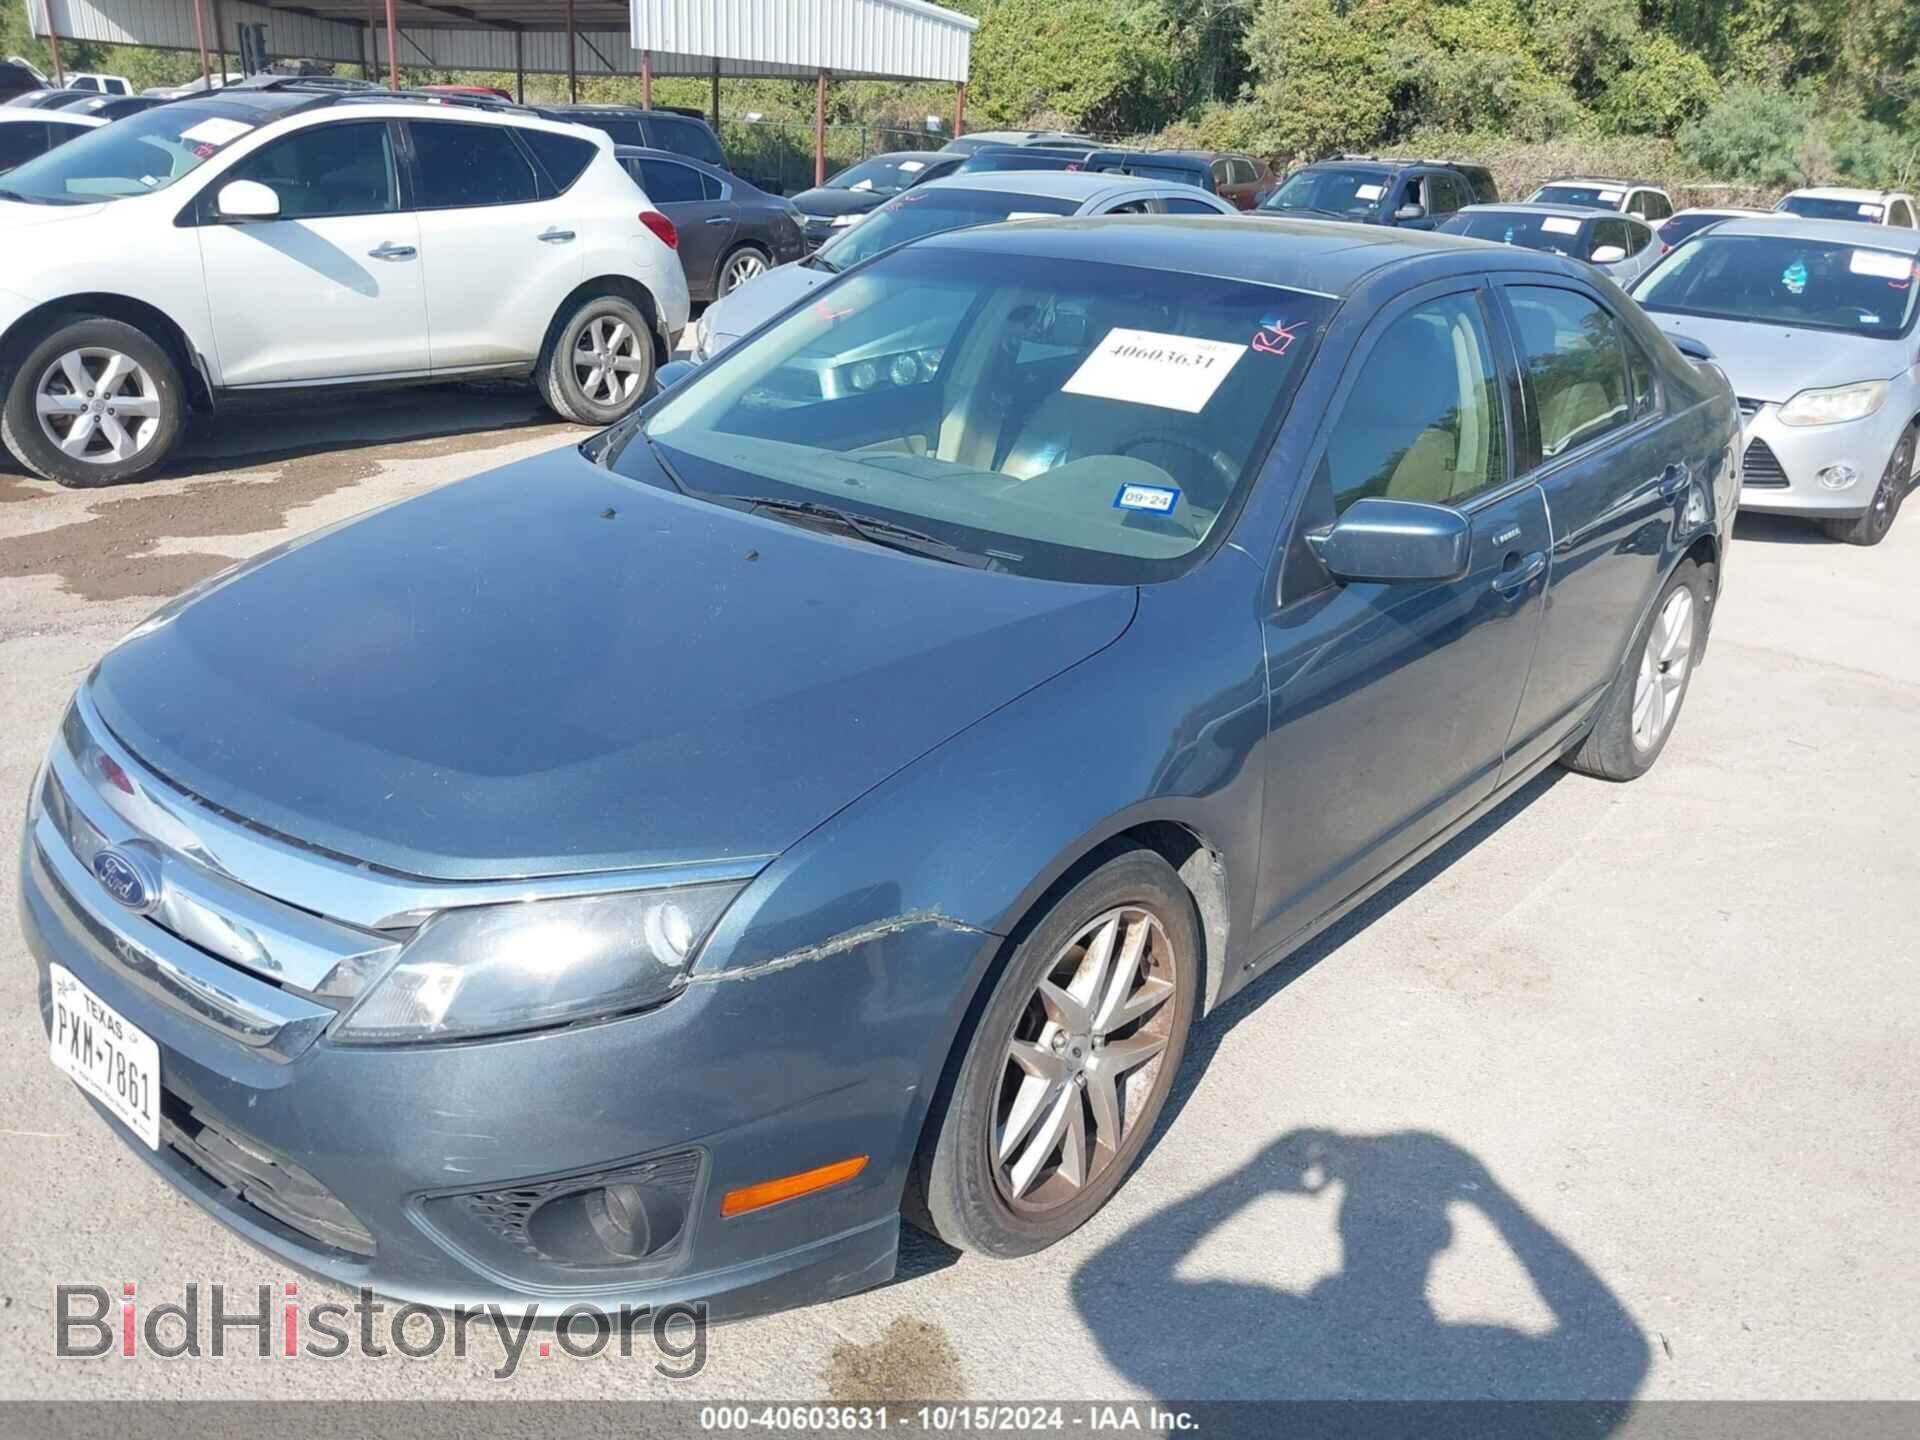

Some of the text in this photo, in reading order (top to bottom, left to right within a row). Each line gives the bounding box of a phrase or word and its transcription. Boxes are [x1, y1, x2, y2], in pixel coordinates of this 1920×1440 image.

[1109, 344, 1216, 369] 40603631
[101, 857, 134, 898] Ford
[83, 993, 123, 1041] TEXAS
